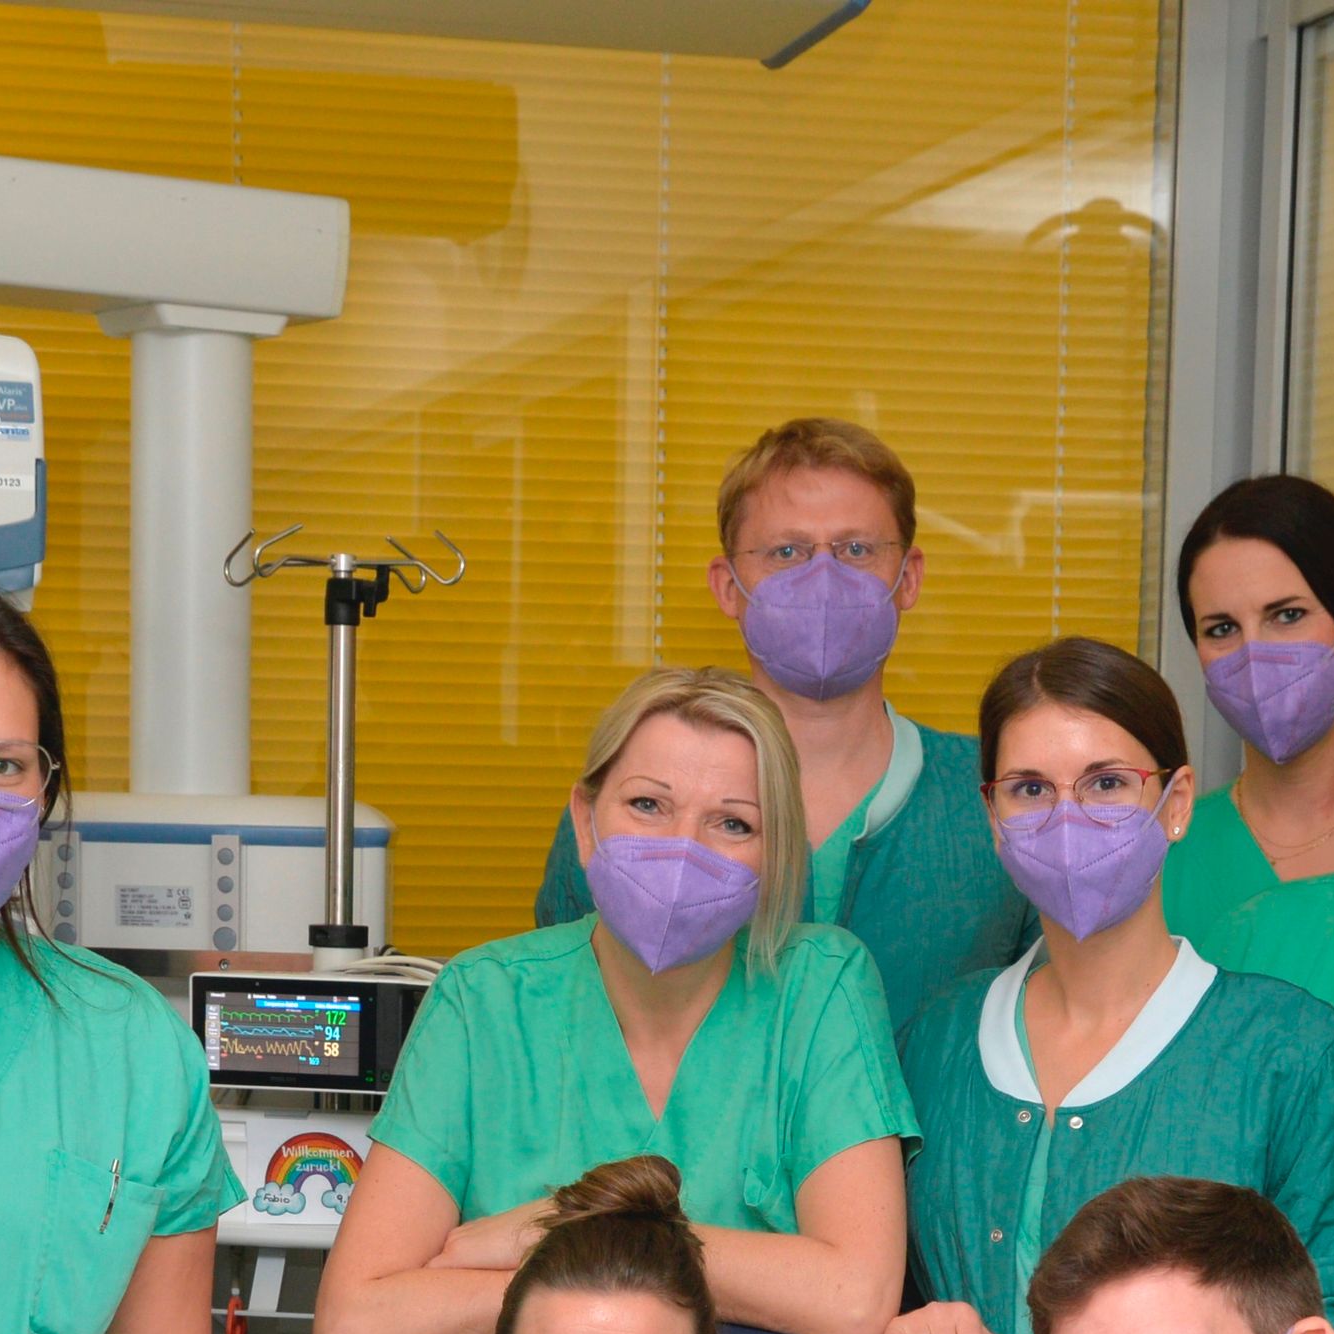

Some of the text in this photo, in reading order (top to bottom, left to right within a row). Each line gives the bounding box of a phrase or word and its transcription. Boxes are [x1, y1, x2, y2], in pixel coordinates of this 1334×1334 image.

[325, 1010, 347, 1026] 172
[325, 1026, 341, 1041] 94
[323, 1042, 340, 1057] 58
[281, 1145, 355, 1159] Willkommen
[263, 1193, 291, 1204] Fabio
